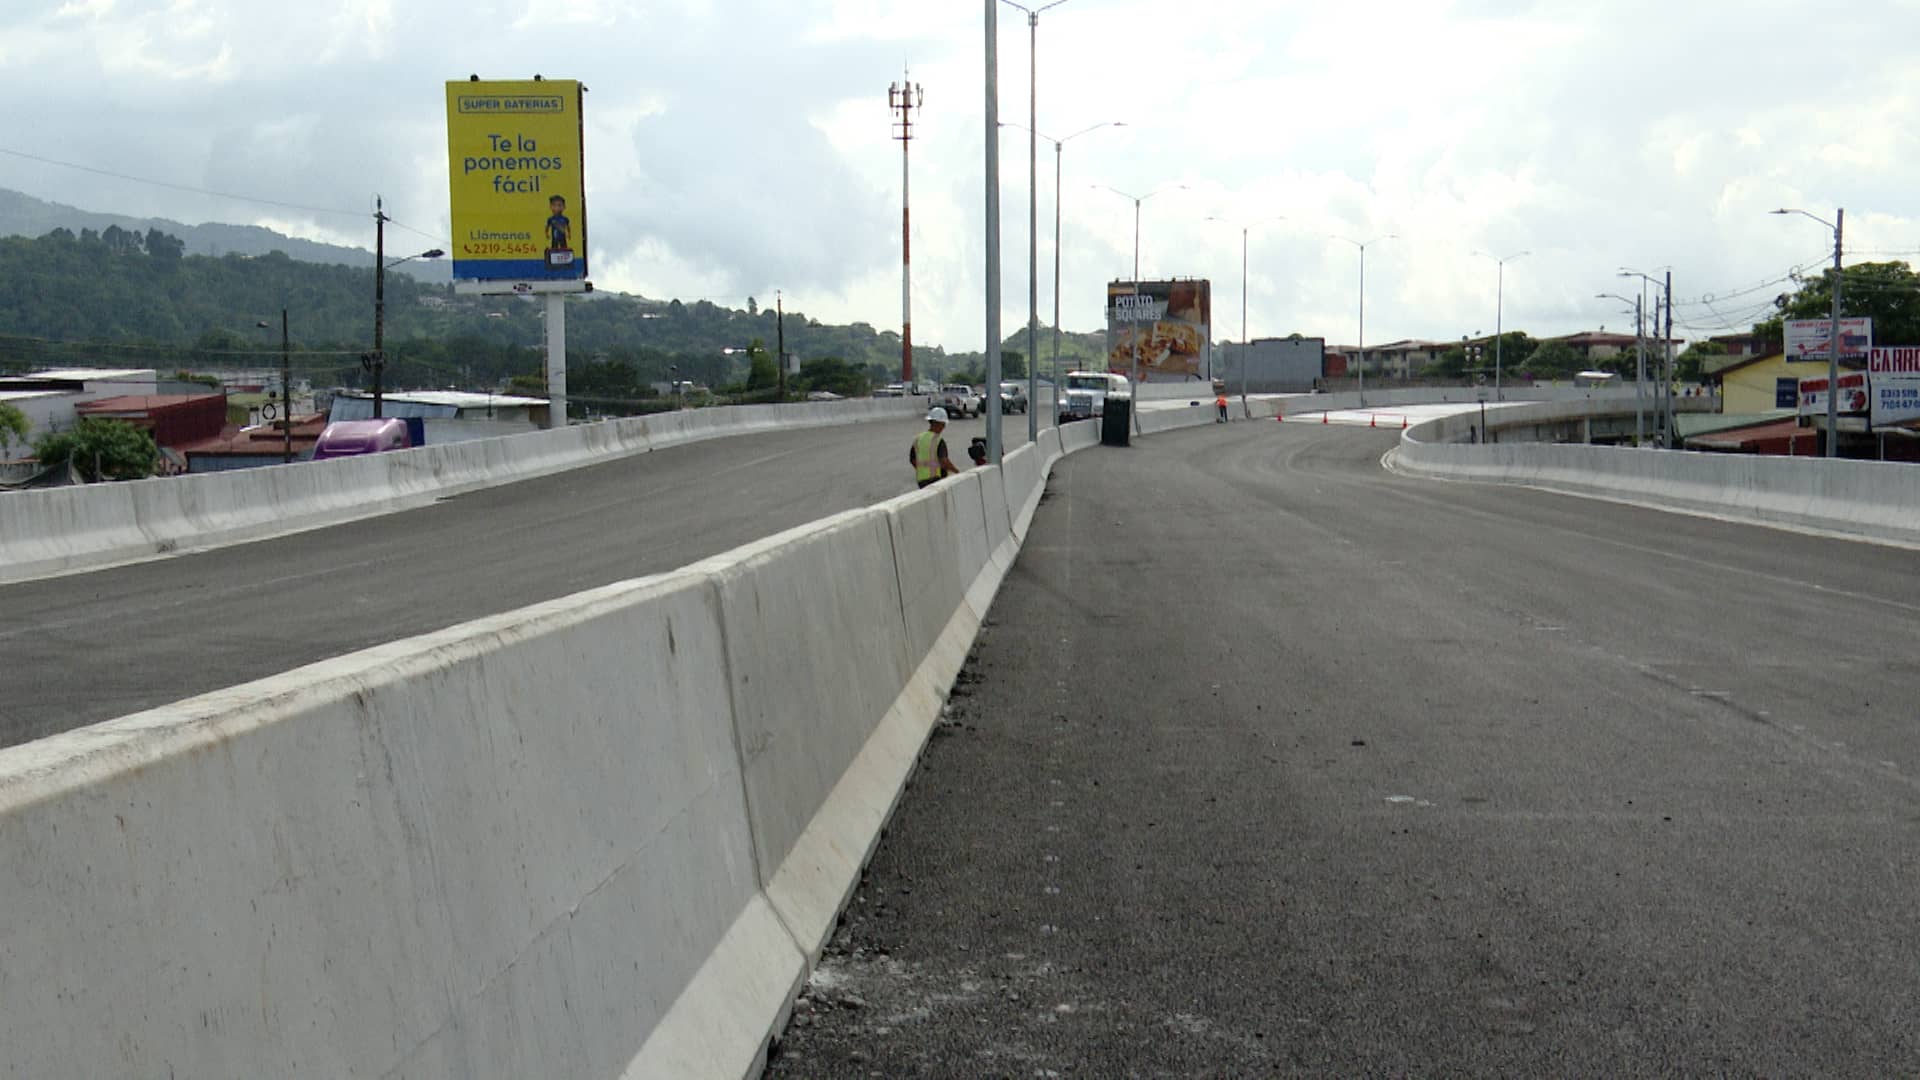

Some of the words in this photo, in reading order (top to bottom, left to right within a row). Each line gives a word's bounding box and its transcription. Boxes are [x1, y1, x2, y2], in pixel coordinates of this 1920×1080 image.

[464, 100, 500, 110] SUPER
[504, 99, 559, 109] BATERIAS
[488, 134, 512, 152] Te
[518, 133, 536, 152] la
[464, 156, 562, 175] ponemos
[493, 175, 540, 193] fácil
[474, 243, 537, 254] 2219-5454
[1115, 295, 1153, 308] POTATO
